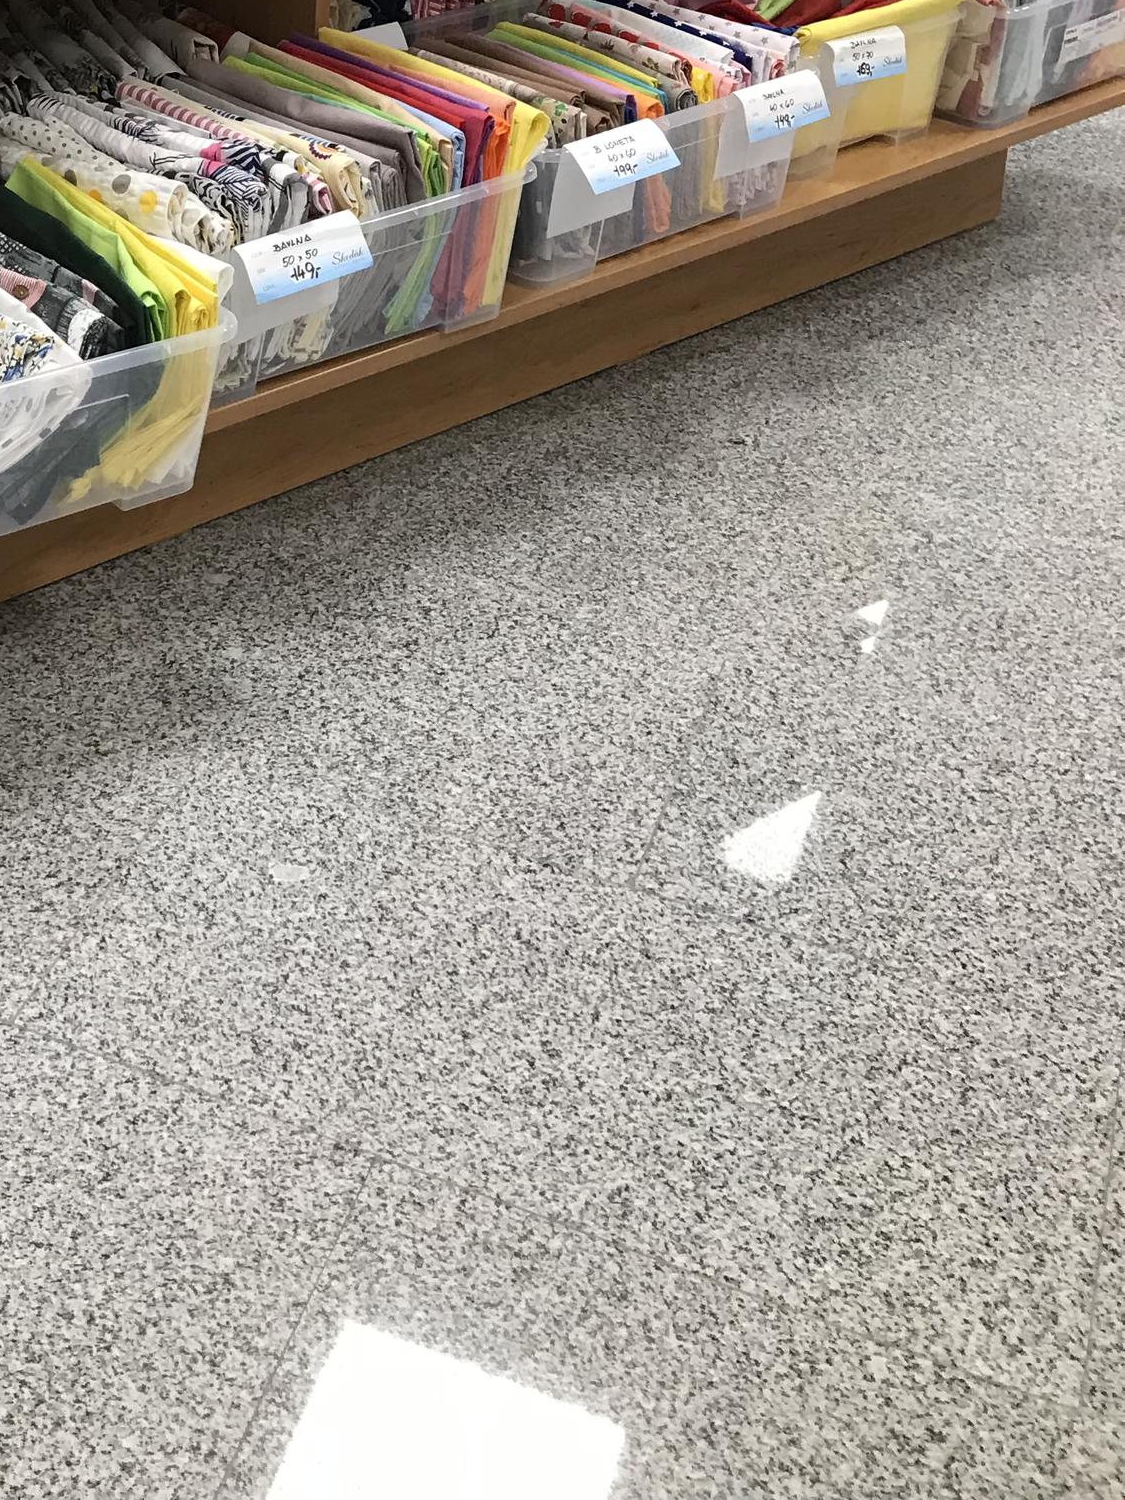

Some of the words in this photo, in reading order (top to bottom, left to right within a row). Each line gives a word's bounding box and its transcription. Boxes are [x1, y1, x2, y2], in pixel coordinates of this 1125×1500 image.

[607, 154, 618, 163] 40
[625, 148, 636, 159] 60
[273, 234, 312, 252] BAVLNA
[282, 255, 294, 268] 50
[305, 248, 318, 260] 50
